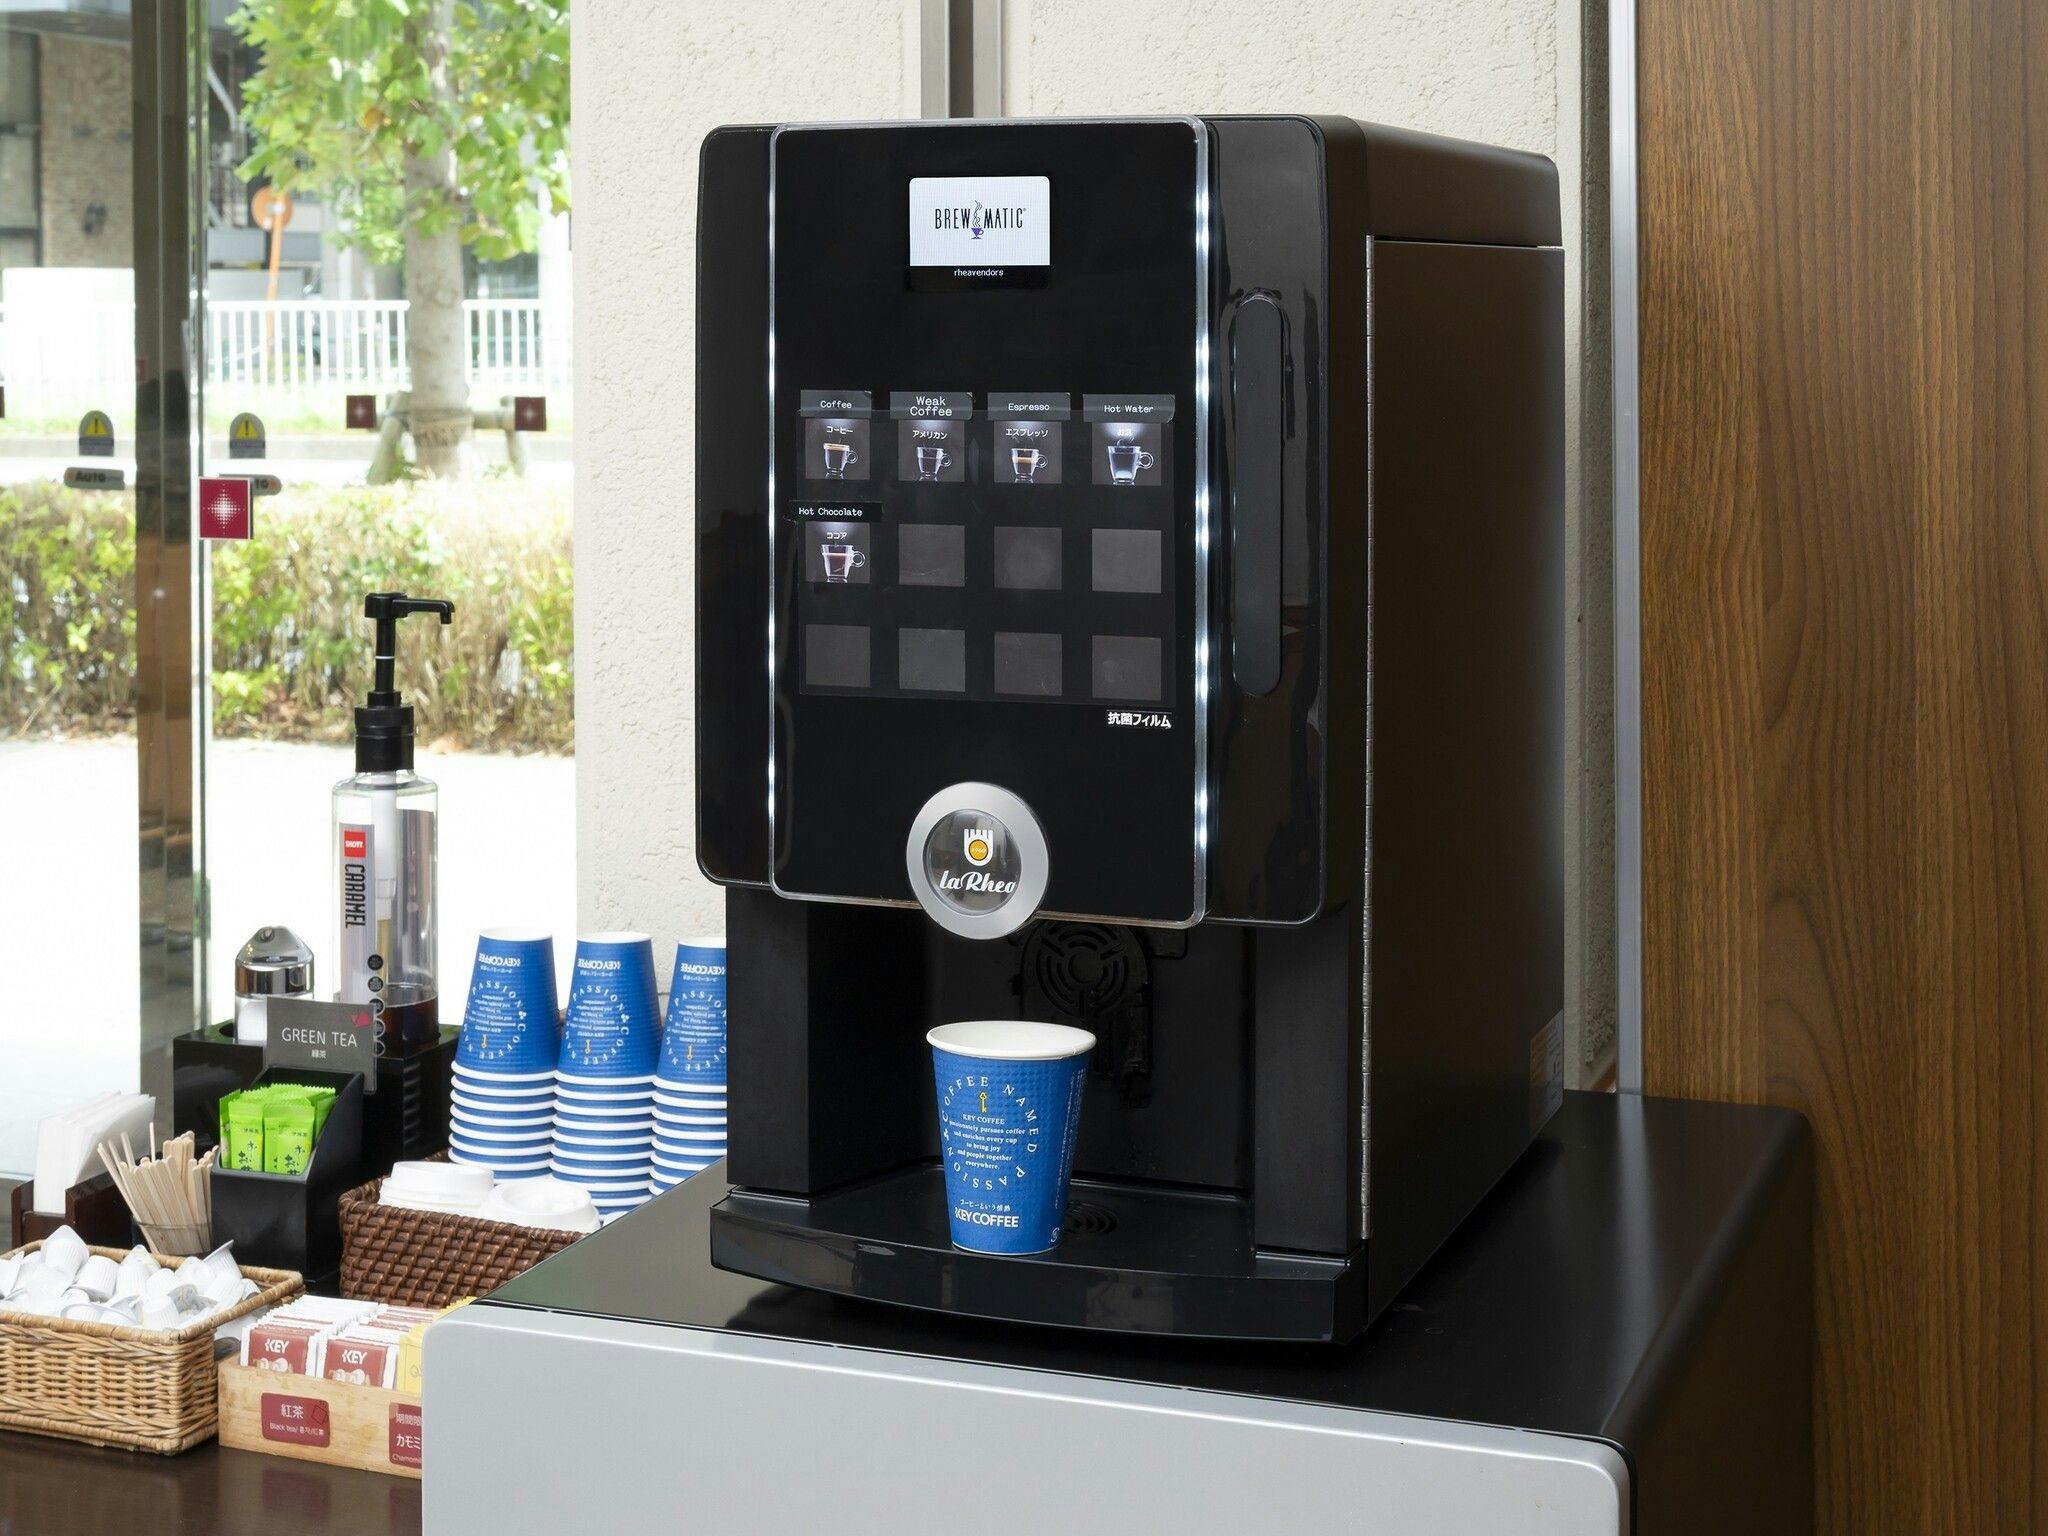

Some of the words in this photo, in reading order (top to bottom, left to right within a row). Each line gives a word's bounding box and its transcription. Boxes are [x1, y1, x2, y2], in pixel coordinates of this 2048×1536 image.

[935, 208, 971, 229] BREW
[954, 268, 1004, 277] rheavendors
[820, 400, 852, 409] Coffee
[916, 396, 946, 406] Weak
[910, 406, 953, 417] Coffee
[1008, 403, 1050, 412] Espresso
[1104, 405, 1121, 413] Hot
[1125, 405, 1154, 414] Water
[826, 425, 854, 435] コーヒー
[912, 430, 948, 440] アメリカン
[1005, 428, 1049, 438] エスプレッソ
[798, 507, 815, 516] Hot
[818, 507, 863, 517] Chocolate
[826, 531, 848, 540] ココア
[1107, 712, 1172, 729] 抗菌フィルム
[344, 863, 366, 929] CARAMEL
[281, 1027, 326, 1045] GREEN
[331, 1031, 358, 1048] TEA
[941, 1076, 989, 1122] COFFEE
[962, 1113, 977, 1122] KEY
[977, 1116, 1006, 1125] COFFEE
[1003, 1084, 1039, 1153] NAMED
[986, 1136, 1004, 1144] every
[973, 1143, 989, 1152] bring
[990, 1145, 1001, 1153] joy
[966, 1150, 985, 1159] people
[986, 1154, 1013, 1162] together
[947, 1146, 1026, 1190] PASSION
[264, 1338, 290, 1354] KEY
[341, 1349, 368, 1365] KEY
[281, 1403, 304, 1419] 紅茶
[269, 1422, 287, 1432] Black
[396, 1433, 422, 1450] カモミ
